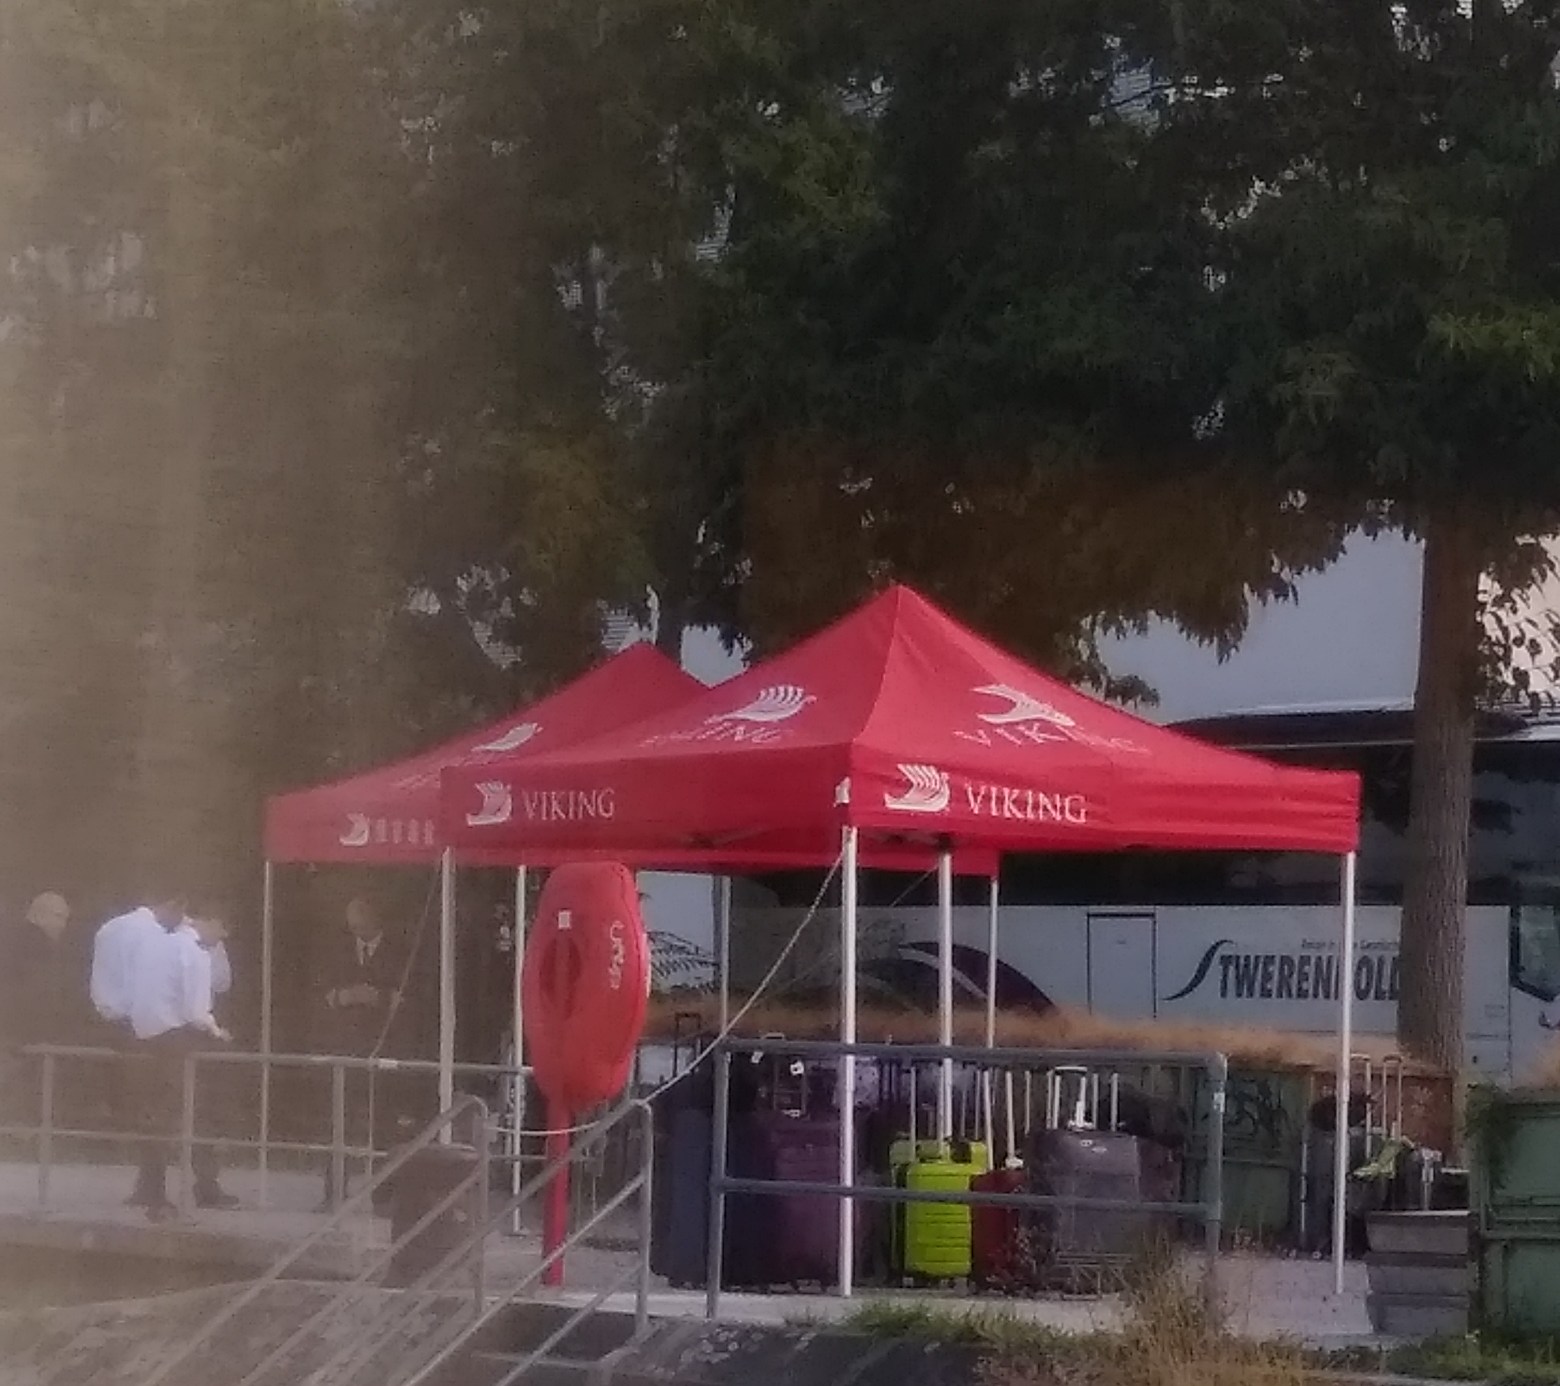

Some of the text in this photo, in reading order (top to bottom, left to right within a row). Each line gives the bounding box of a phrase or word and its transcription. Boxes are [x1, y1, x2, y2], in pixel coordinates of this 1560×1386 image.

[521, 788, 616, 820] VIKING
[964, 781, 1087, 823] VIKING
[1218, 954, 1400, 1001] TWERENOLD
